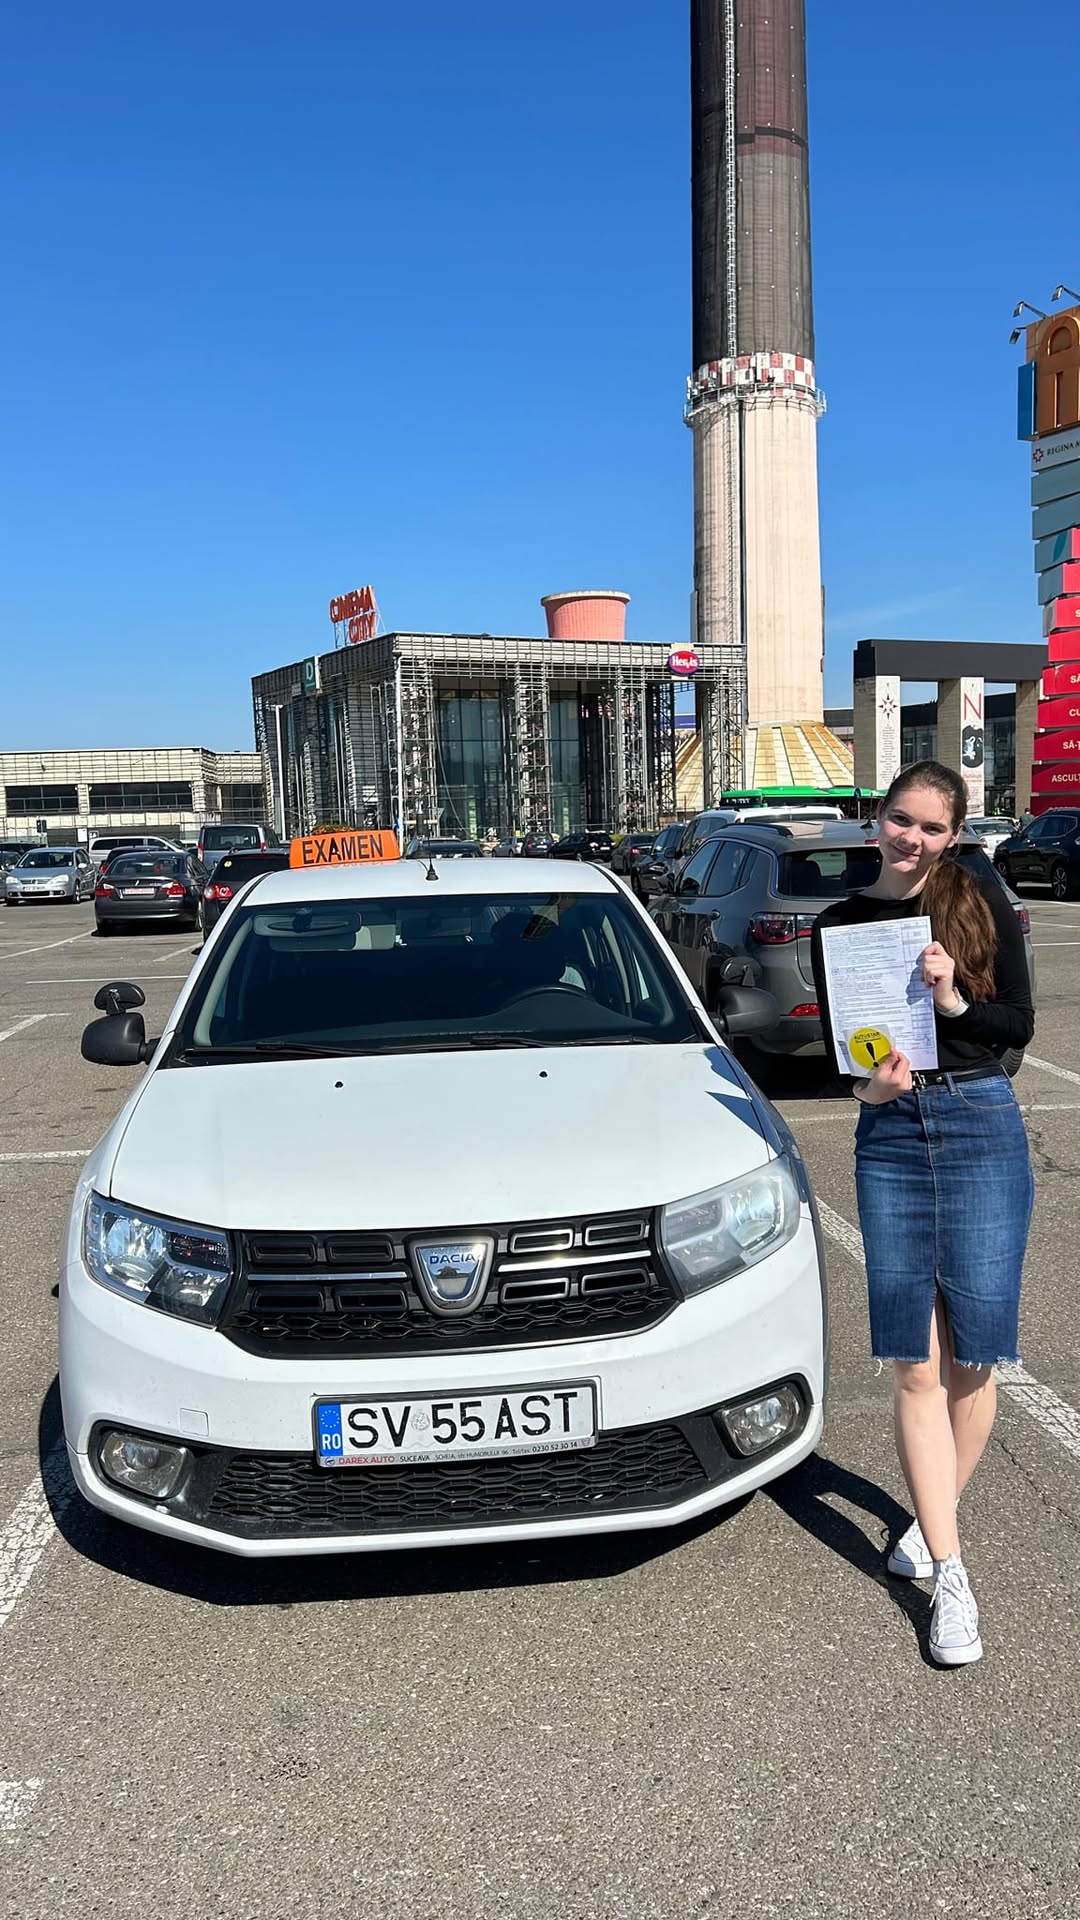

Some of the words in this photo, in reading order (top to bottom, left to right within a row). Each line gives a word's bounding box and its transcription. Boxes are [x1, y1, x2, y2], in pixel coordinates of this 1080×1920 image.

[330, 585, 374, 623] CINEMA
[349, 611, 375, 643] CITY
[305, 661, 314, 680] D
[963, 693, 982, 721] N
[302, 834, 383, 864] EXAMEN
[429, 1253, 475, 1264] DACIA
[348, 1405, 411, 1448] SV
[431, 1401, 486, 1444] 55
[494, 1391, 578, 1441] AST
[322, 1433, 341, 1450] RO
[338, 1457, 369, 1465] DAREX
[369, 1455, 395, 1463] AUTO
[400, 1455, 430, 1463] SUCEAVA
